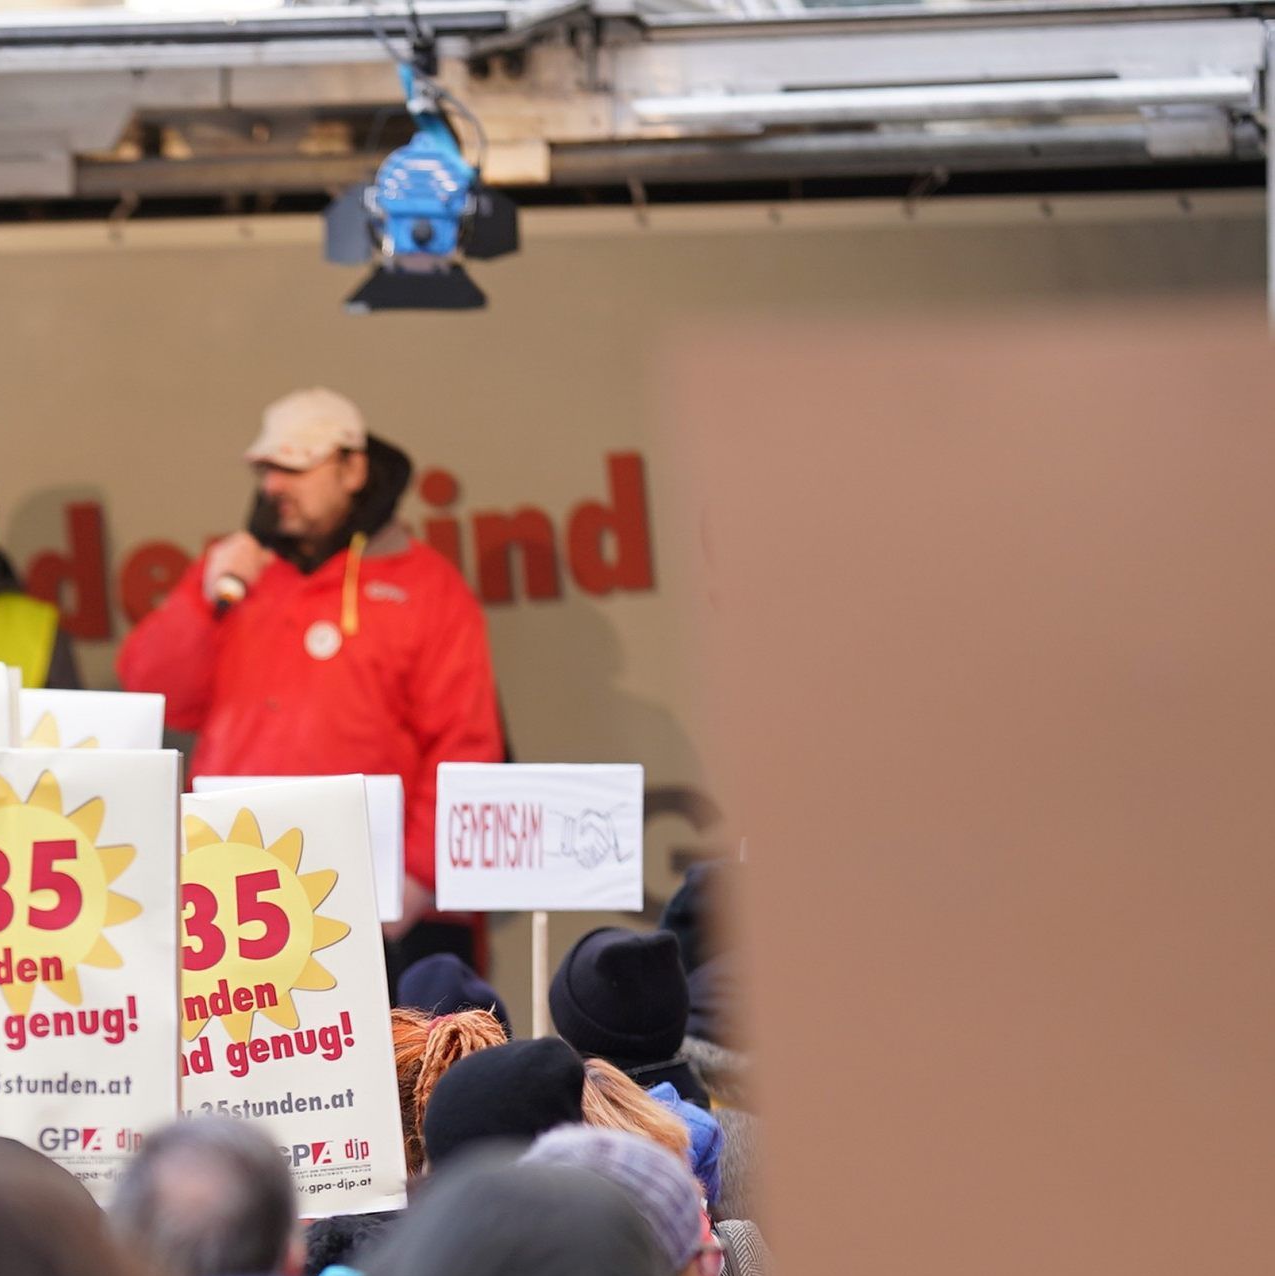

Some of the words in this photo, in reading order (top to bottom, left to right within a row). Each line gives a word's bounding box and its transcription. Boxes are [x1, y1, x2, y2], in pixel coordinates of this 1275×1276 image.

[404, 449, 652, 605] ind
[449, 803, 543, 869] GEMEINSAM
[181, 869, 291, 972] 35
[3, 995, 139, 1051] genug!
[183, 978, 278, 1022] nden
[226, 1011, 355, 1078] genug!
[344, 1138, 370, 1161] djp
